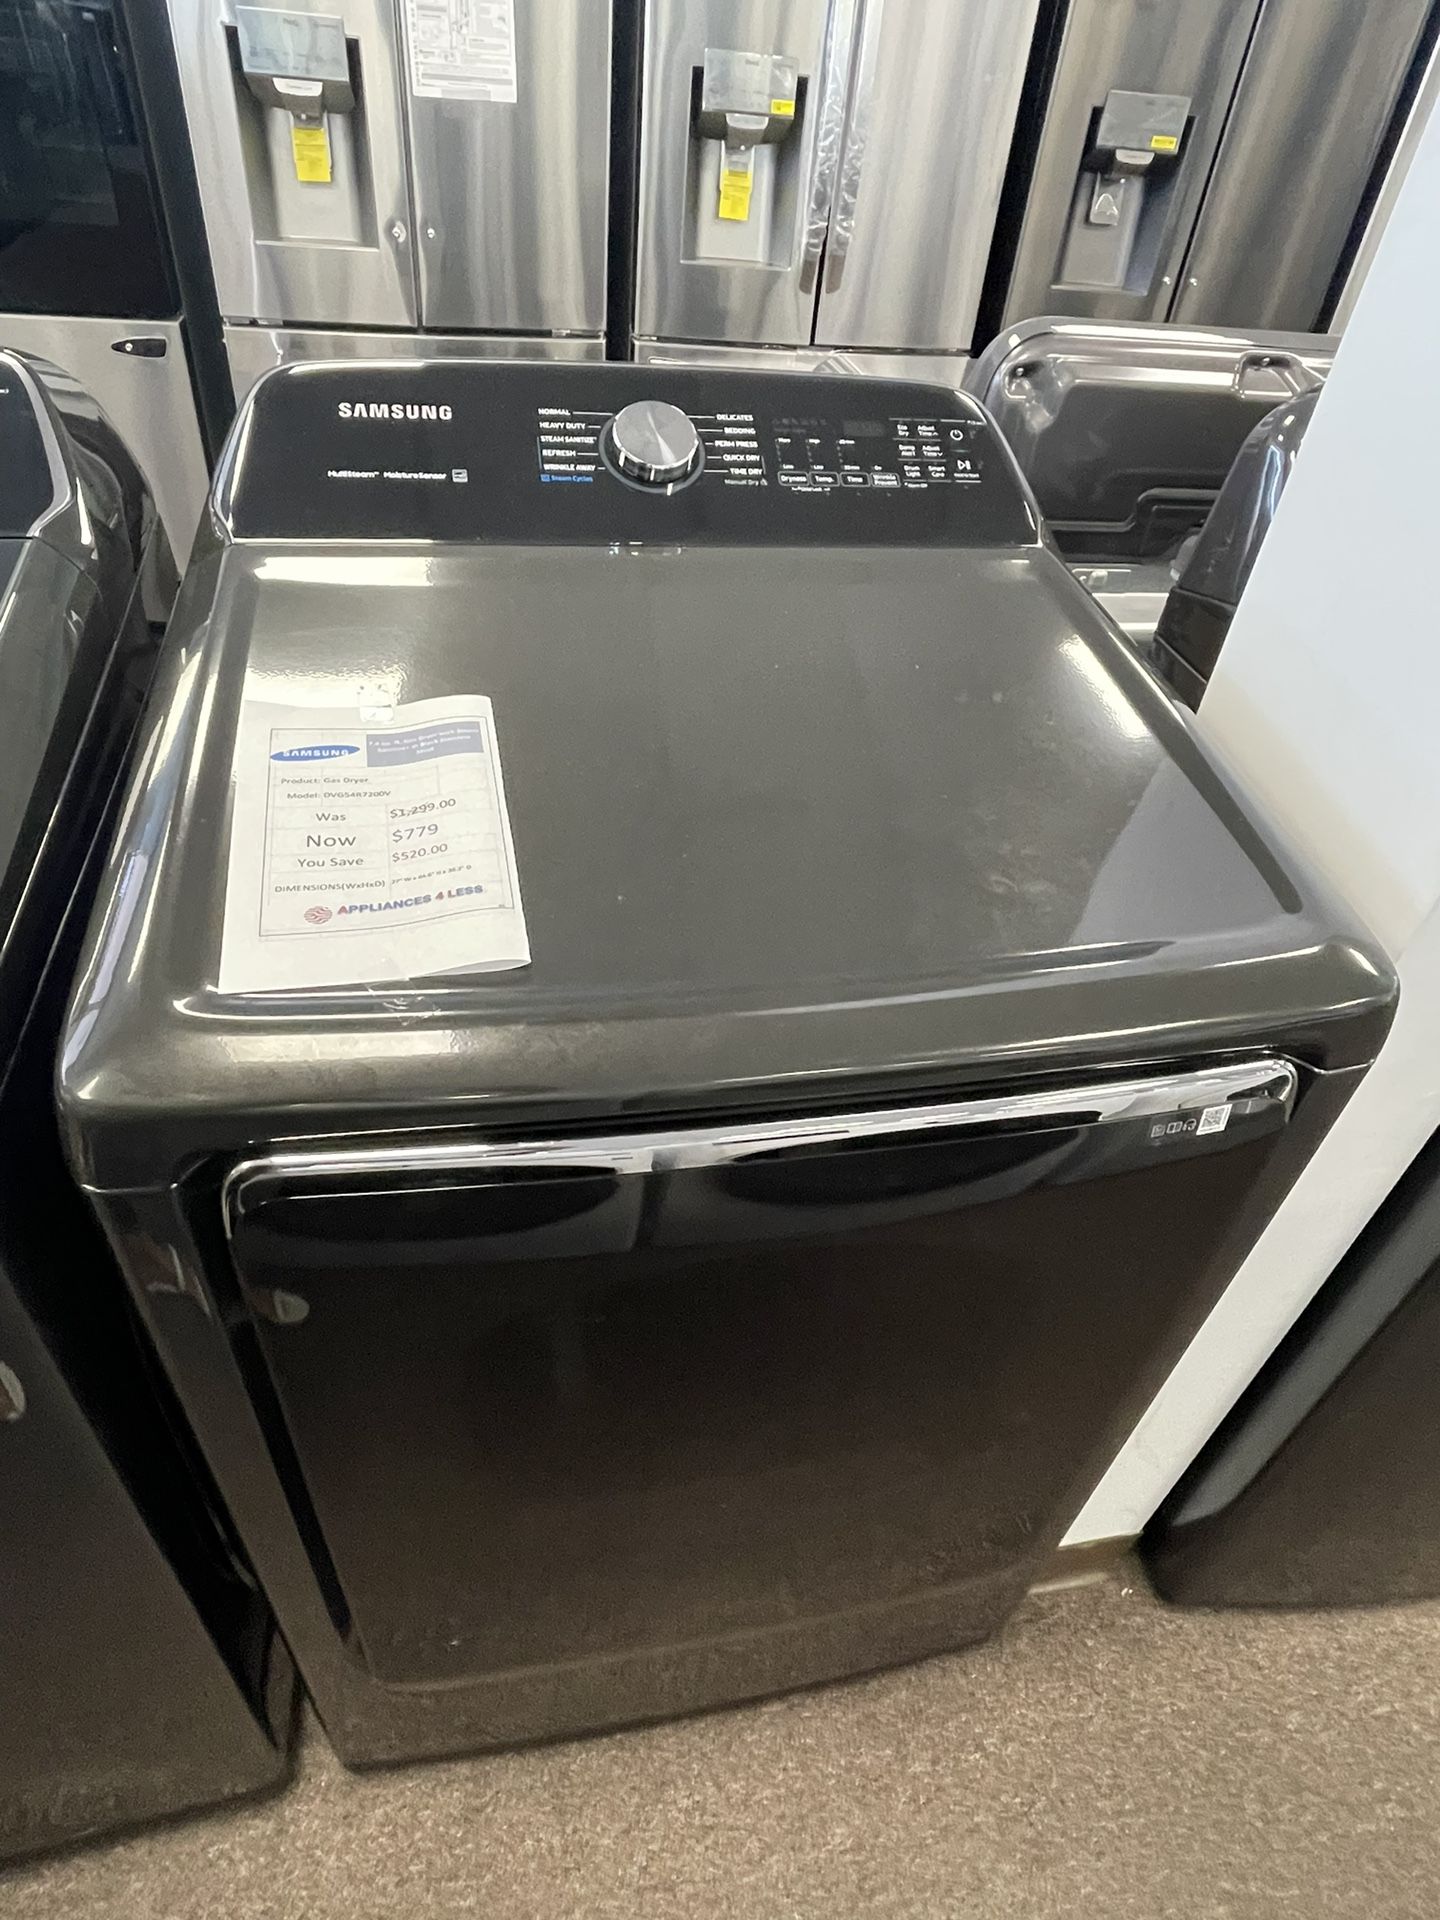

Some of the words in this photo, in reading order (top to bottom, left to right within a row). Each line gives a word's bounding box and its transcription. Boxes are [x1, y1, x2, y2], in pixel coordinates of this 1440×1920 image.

[338, 402, 453, 420] SAMSUNG
[716, 413, 754, 421] DELICATES
[283, 749, 349, 757] SAMSUNG
[315, 812, 347, 822] Was
[390, 798, 457, 819] $1,299.00
[306, 834, 357, 848] Now
[392, 823, 439, 844] $779
[297, 858, 325, 868] You
[330, 857, 364, 868] Save
[392, 843, 448, 863] $520.00
[274, 879, 386, 893] DIMENSIONS(WxHxD)
[337, 894, 432, 916] APPLIANCES
[435, 891, 445, 901] 4
[448, 885, 484, 899] LESS
